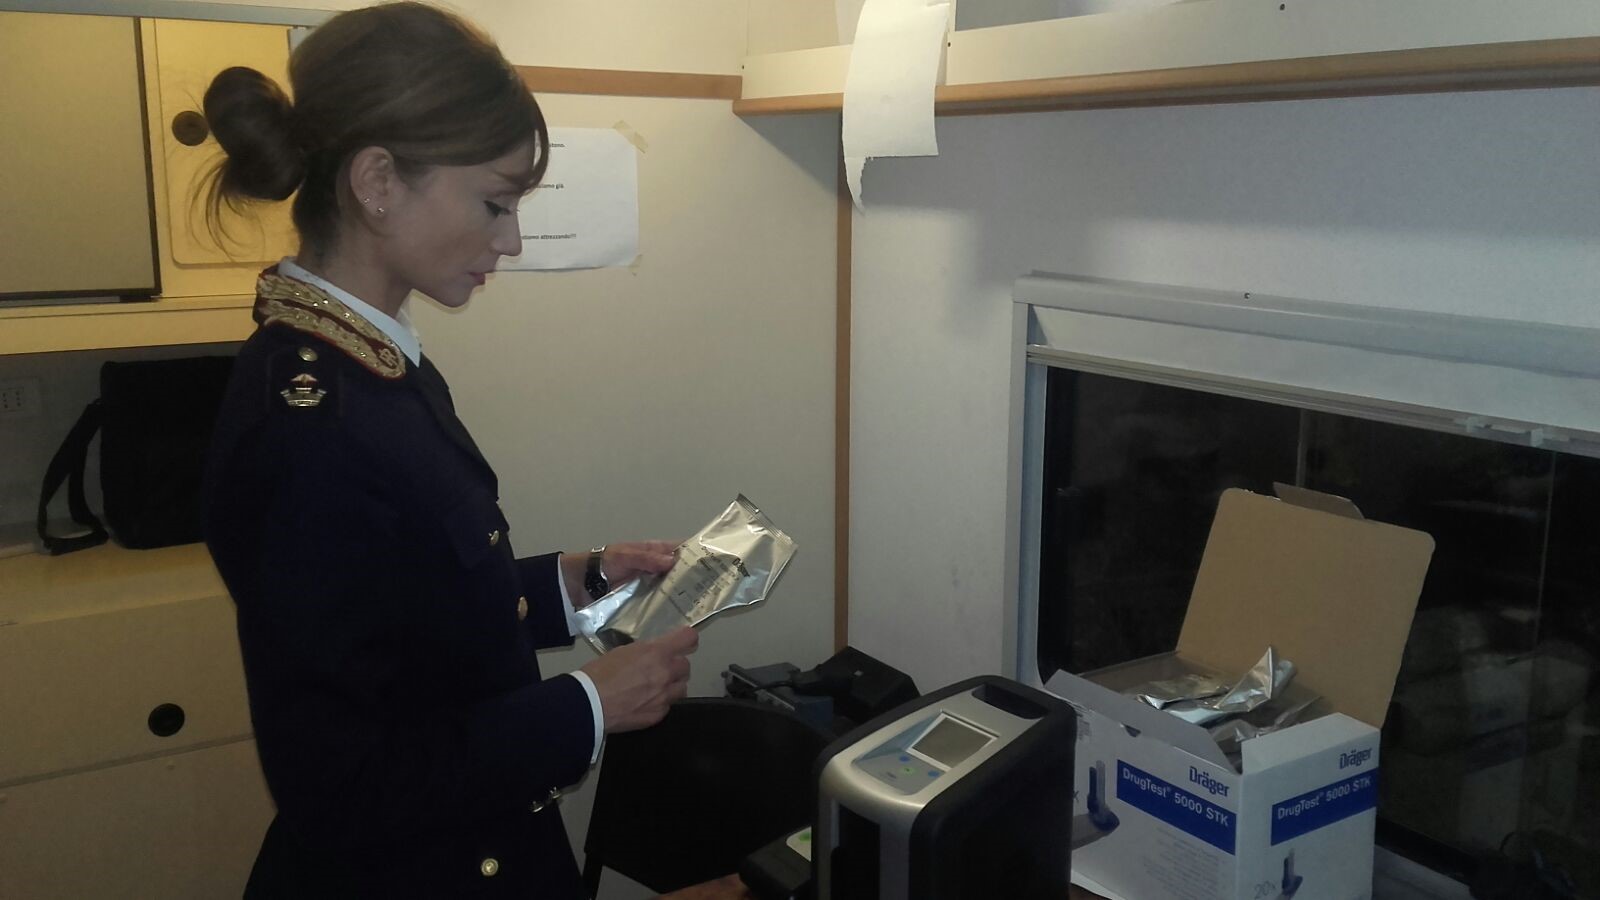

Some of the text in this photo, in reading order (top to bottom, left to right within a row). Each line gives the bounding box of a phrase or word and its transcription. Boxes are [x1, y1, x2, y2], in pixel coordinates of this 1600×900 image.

[1339, 747, 1373, 770] Dräger
[1189, 765, 1231, 798] Dräger
[1325, 784, 1350, 802] 5000
[1352, 775, 1372, 792] STK
[1174, 792, 1203, 815] 5000
[1205, 807, 1229, 827] STK
